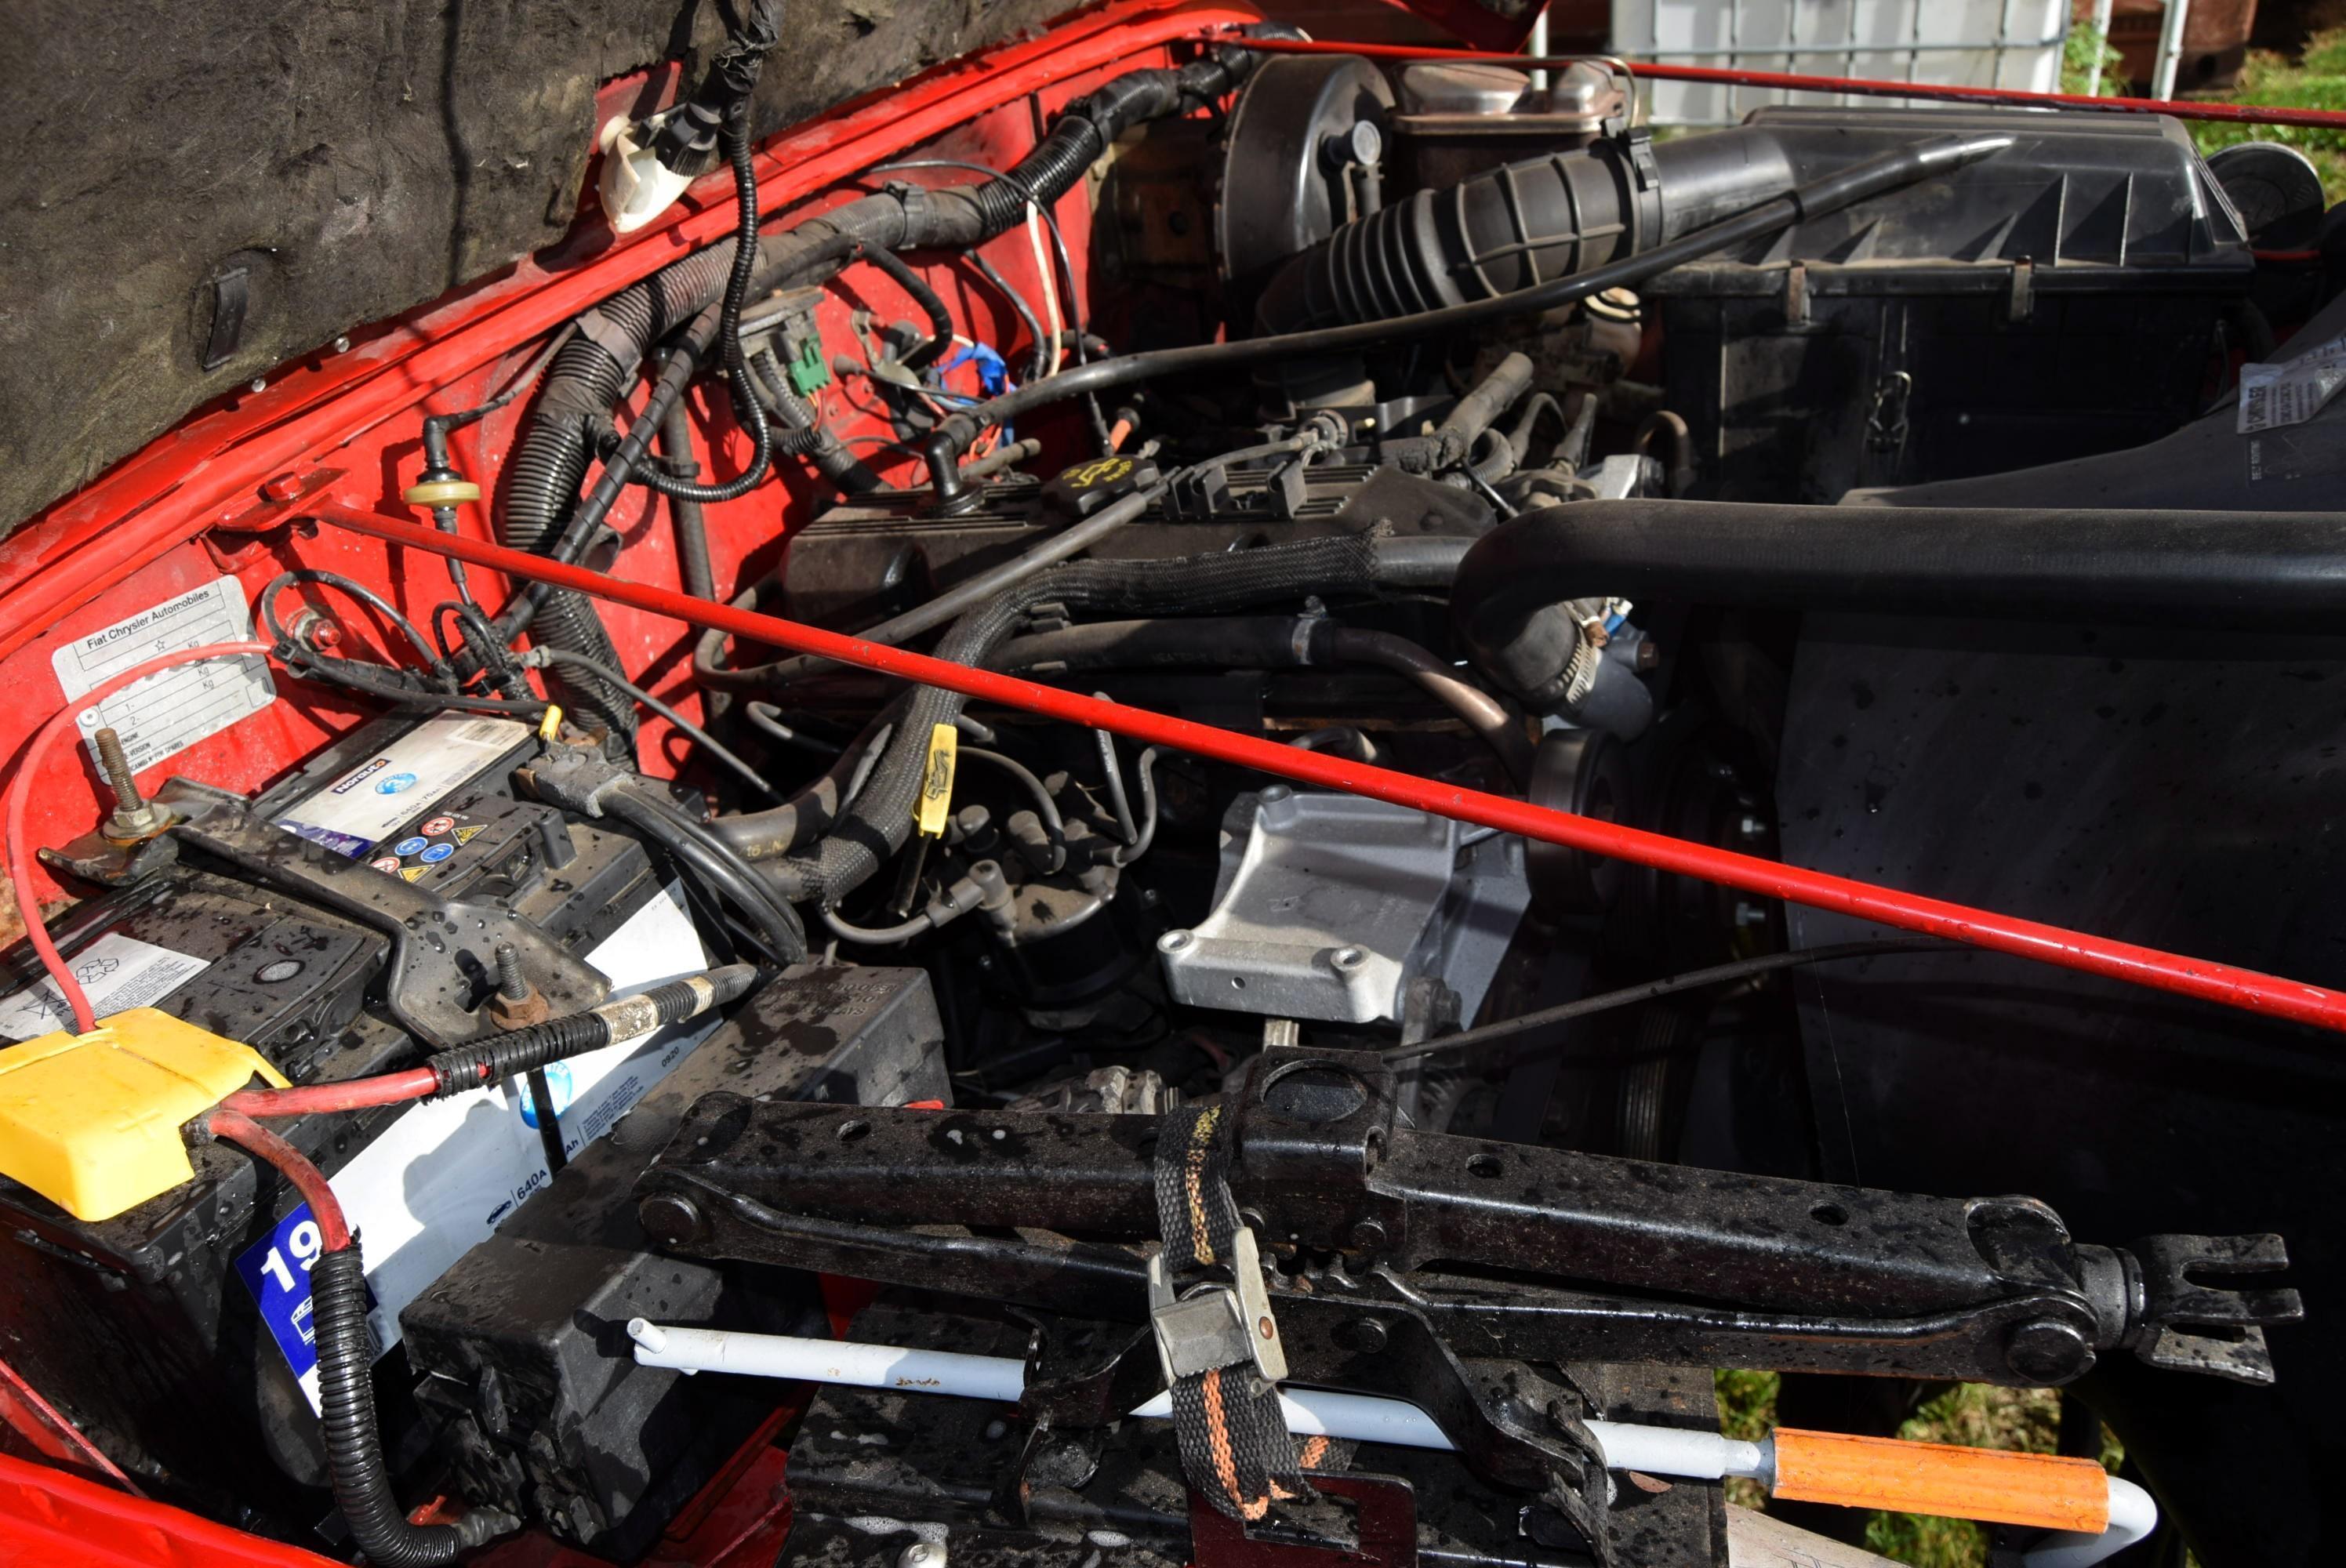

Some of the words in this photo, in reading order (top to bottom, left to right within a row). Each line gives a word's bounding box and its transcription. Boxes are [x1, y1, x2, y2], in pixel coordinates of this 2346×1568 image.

[86, 633, 107, 650] Fiat
[108, 615, 149, 640] Chrysler
[151, 590, 210, 622] Automobiles
[197, 666, 210, 677] Kg
[202, 679, 215, 690] Kg
[336, 760, 386, 793] Norauto
[661, 1046, 680, 1067] 0920
[517, 1169, 547, 1200] 640A
[565, 1139, 579, 1156] Ah
[260, 1220, 323, 1293] 19
